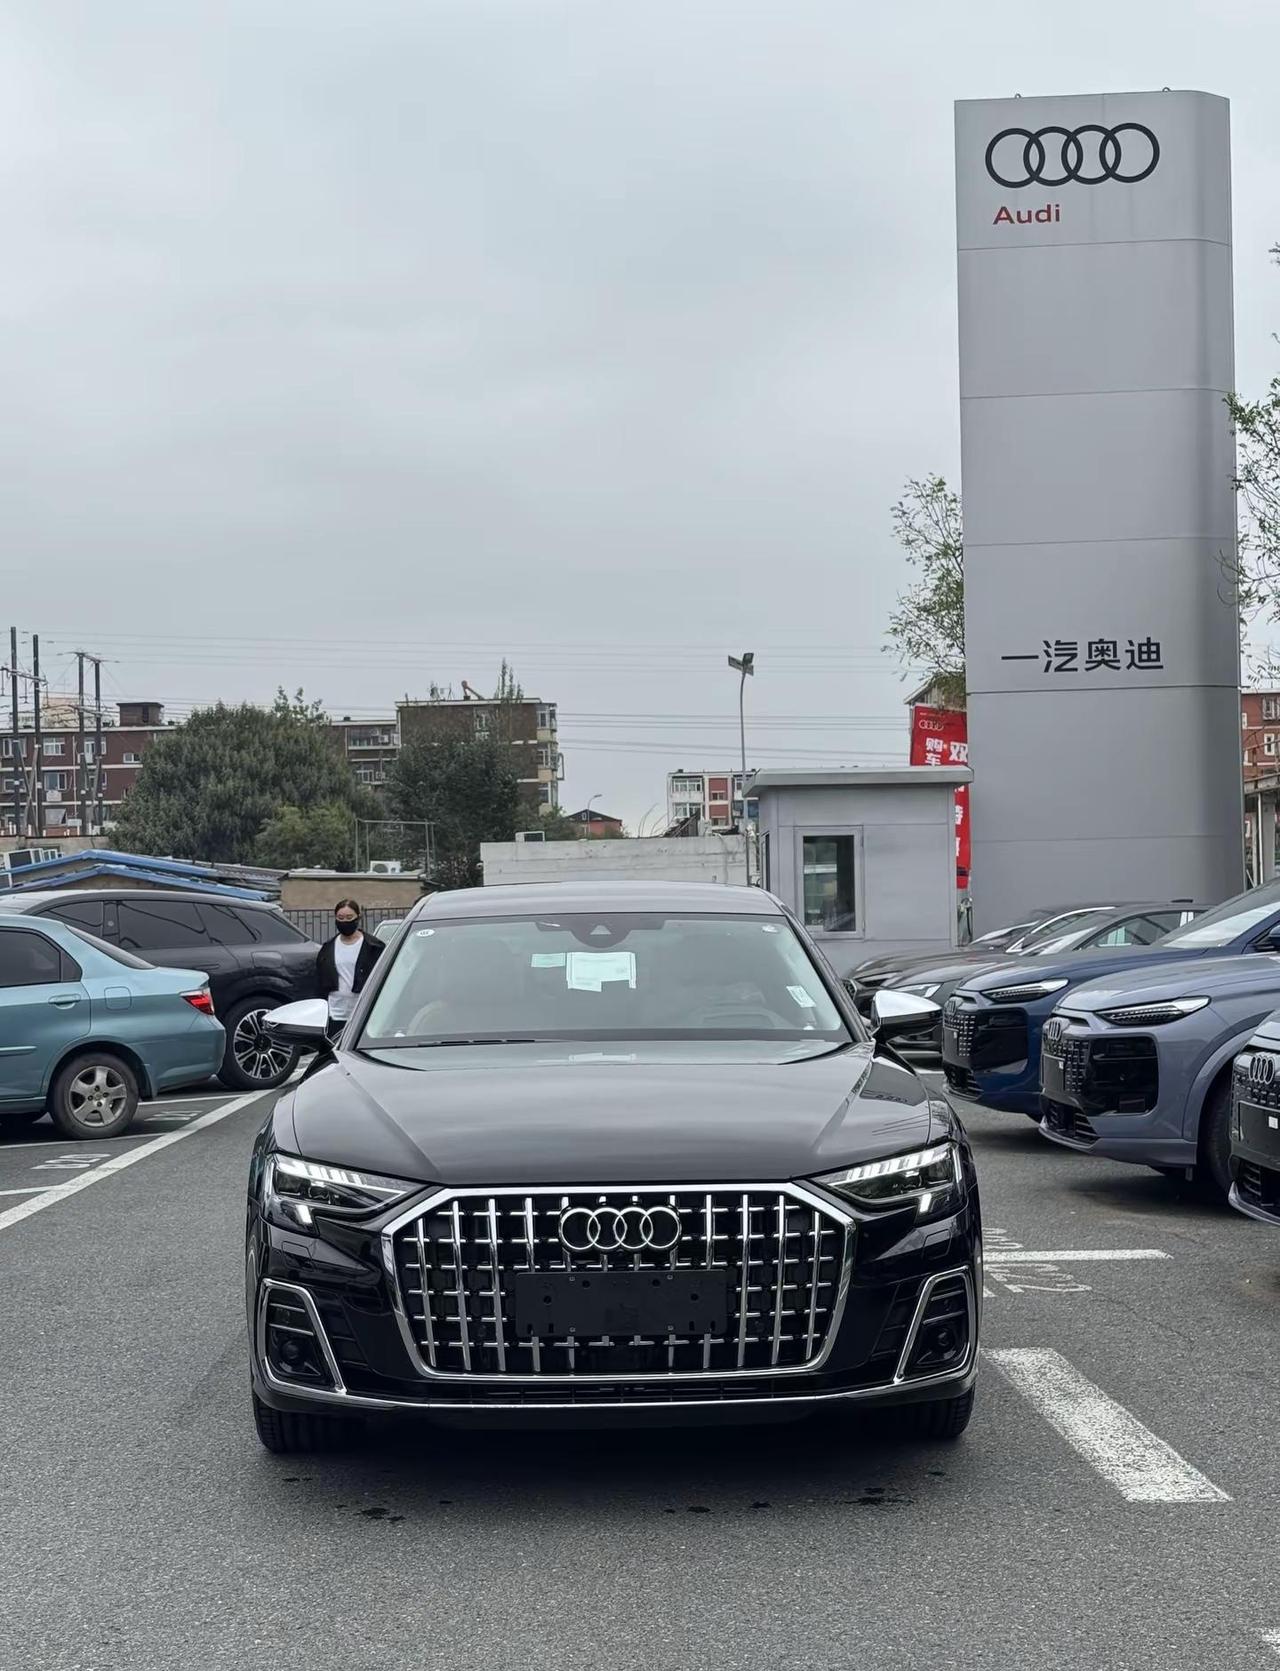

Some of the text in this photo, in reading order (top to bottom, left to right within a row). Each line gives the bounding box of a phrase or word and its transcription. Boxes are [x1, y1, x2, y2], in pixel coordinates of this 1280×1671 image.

[992, 204, 1061, 225] Audi
[1001, 637, 1164, 673] 一汽奥迪
